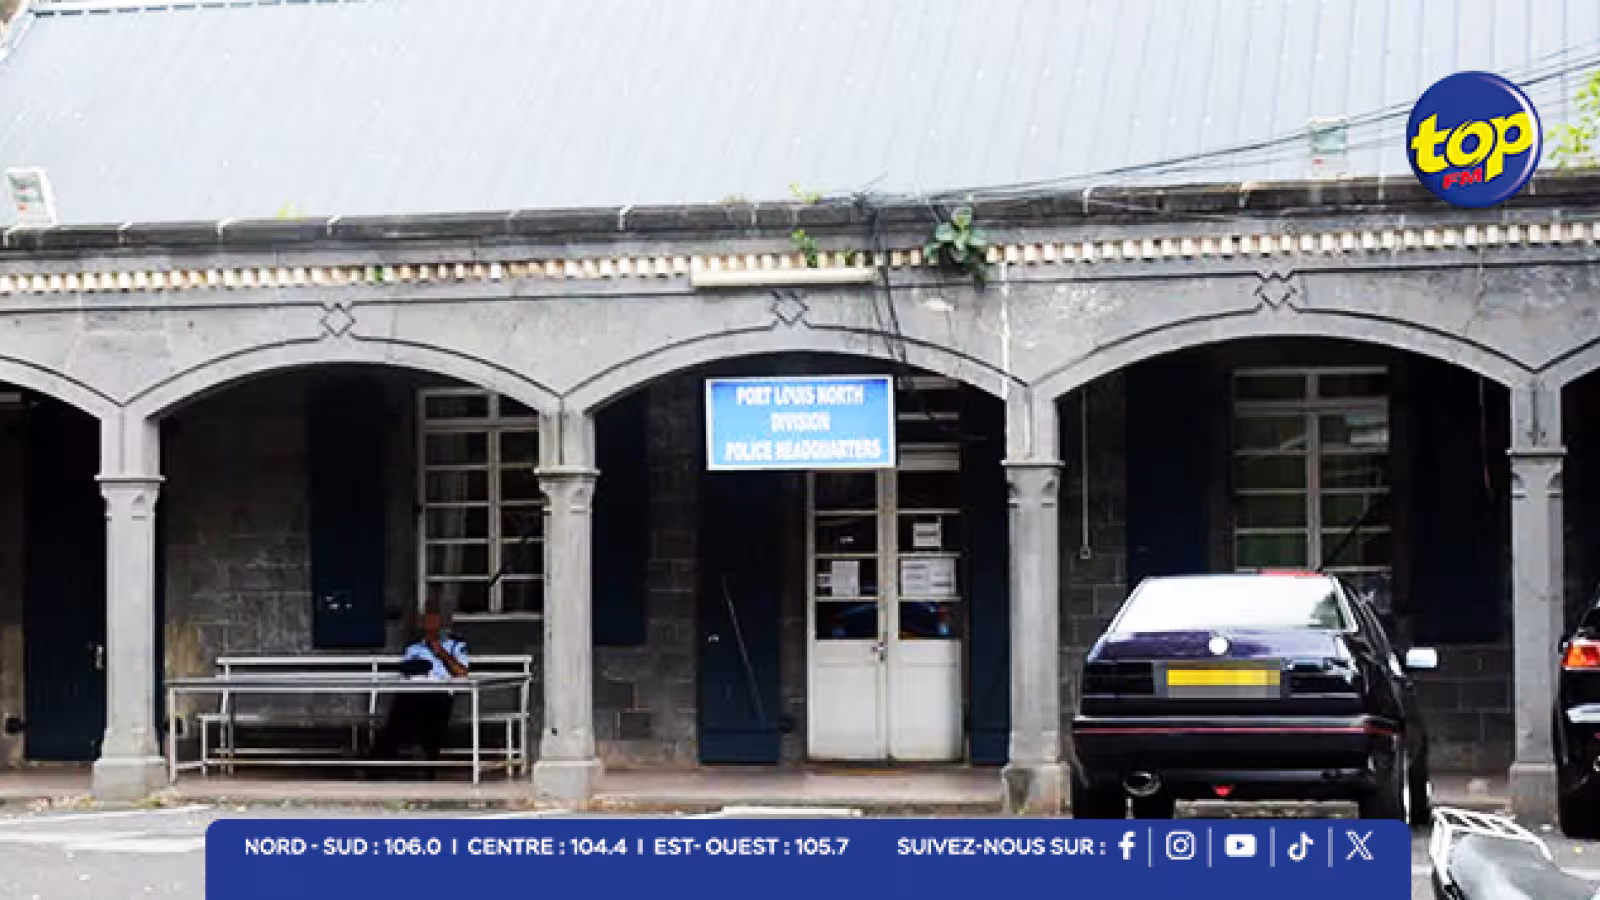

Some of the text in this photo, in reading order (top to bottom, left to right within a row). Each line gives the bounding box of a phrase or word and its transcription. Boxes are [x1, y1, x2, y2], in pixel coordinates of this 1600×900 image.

[736, 385, 770, 405] PORT
[817, 385, 863, 405] NORTH
[771, 411, 831, 432] DIVISION
[725, 441, 773, 461] POLICE
